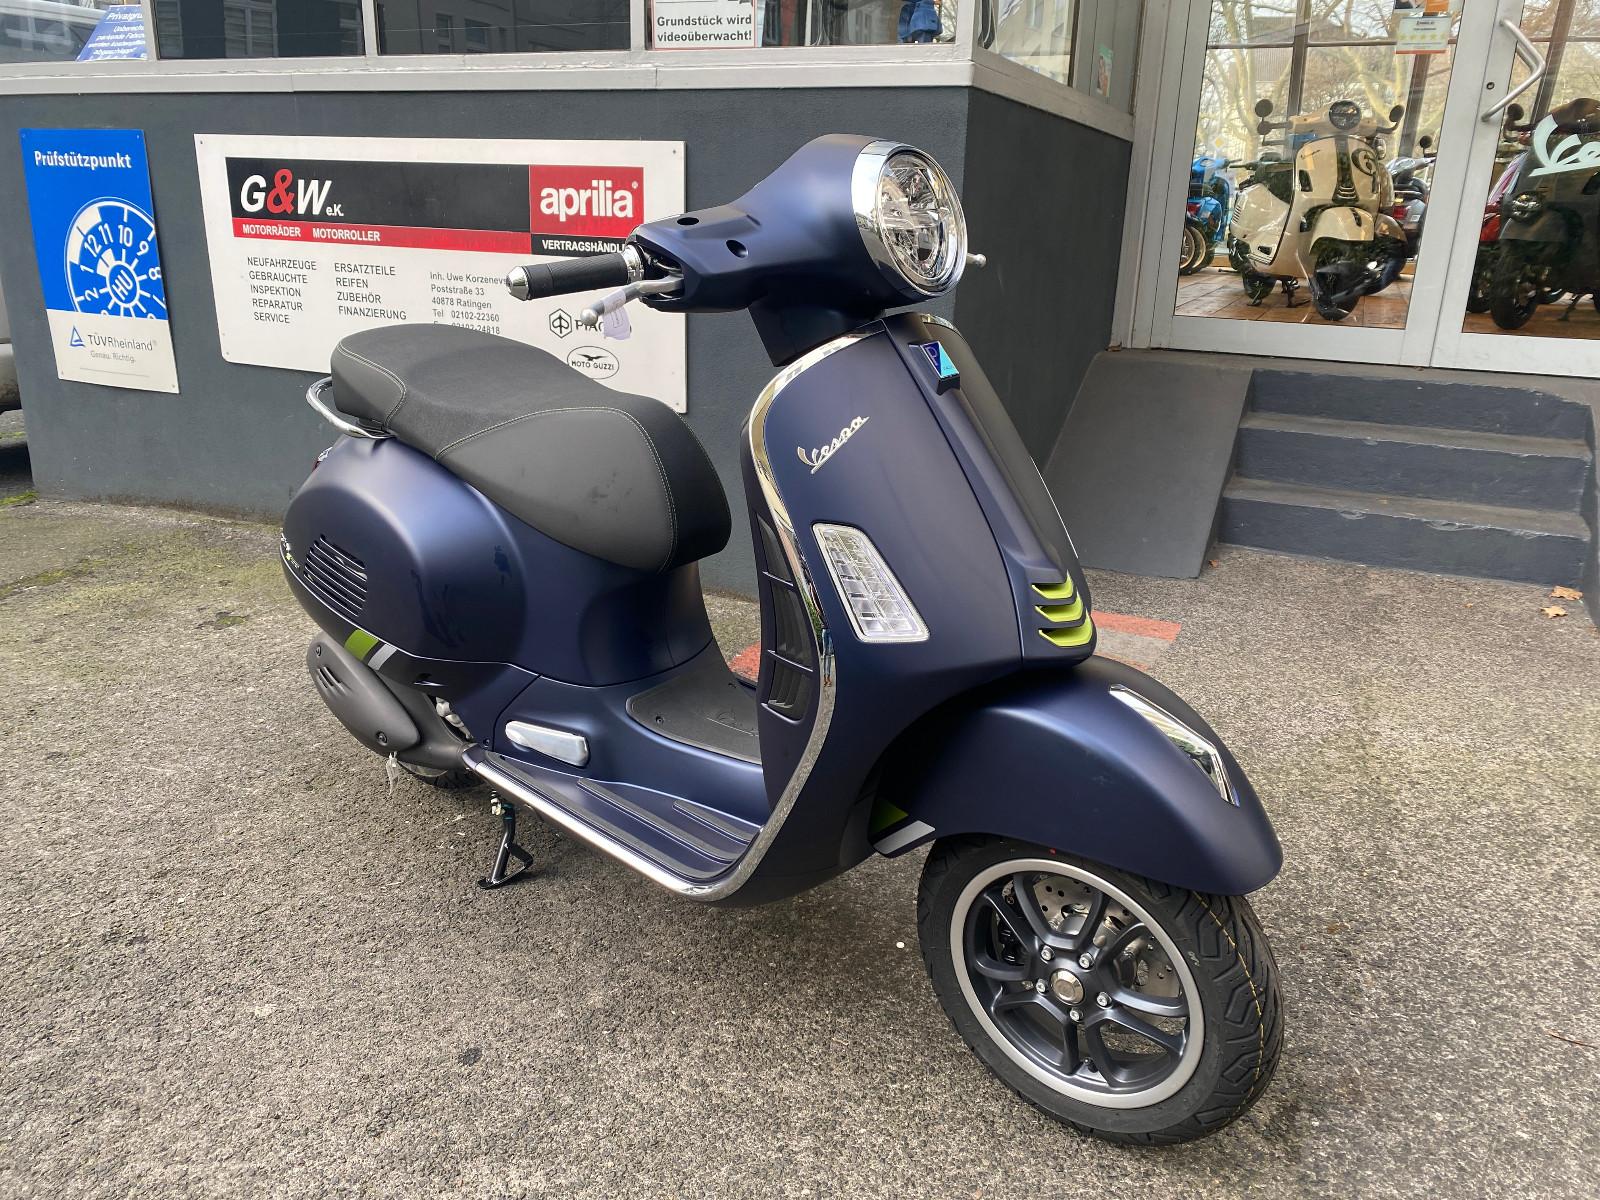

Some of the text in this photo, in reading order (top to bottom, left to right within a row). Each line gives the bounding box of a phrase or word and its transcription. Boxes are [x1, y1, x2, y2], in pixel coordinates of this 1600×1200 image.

[657, 14, 752, 27] Grundstück wird
[657, 30, 752, 42] videoüberwacht!
[34, 150, 132, 170] Prüfstützpunkt
[240, 168, 332, 216] G&W
[540, 179, 633, 222] aprilia
[98, 223, 114, 245] 11
[118, 224, 133, 247] 10
[242, 223, 381, 242] MOTORRÄDER MOTORROLLER
[84, 234, 102, 258] 12
[136, 240, 149, 256] 9
[542, 239, 625, 254] VERTRAGSHÄNDL
[247, 256, 317, 271] NEUFAHRZEUGE
[334, 262, 396, 276] ERSATZTEILE
[249, 270, 308, 284] GEBRAUCHTE
[335, 277, 369, 289] REIFEN
[430, 272, 444, 280] Inh.
[446, 273, 463, 281] Uwe
[111, 269, 133, 301] HU
[250, 284, 301, 298] INSPEKTION
[431, 284, 485, 296] Poststraße 33
[336, 291, 382, 304] ZUBEHÖR
[431, 297, 492, 310] 40878 Ratingen
[252, 298, 303, 312] REPARATUR
[254, 312, 290, 324] SERVICE
[338, 305, 407, 320] FINANZIERUNG
[451, 310, 500, 322] 02102-22360
[571, 360, 615, 370] MOTO GUZZI
[797, 415, 870, 474] Vespa
